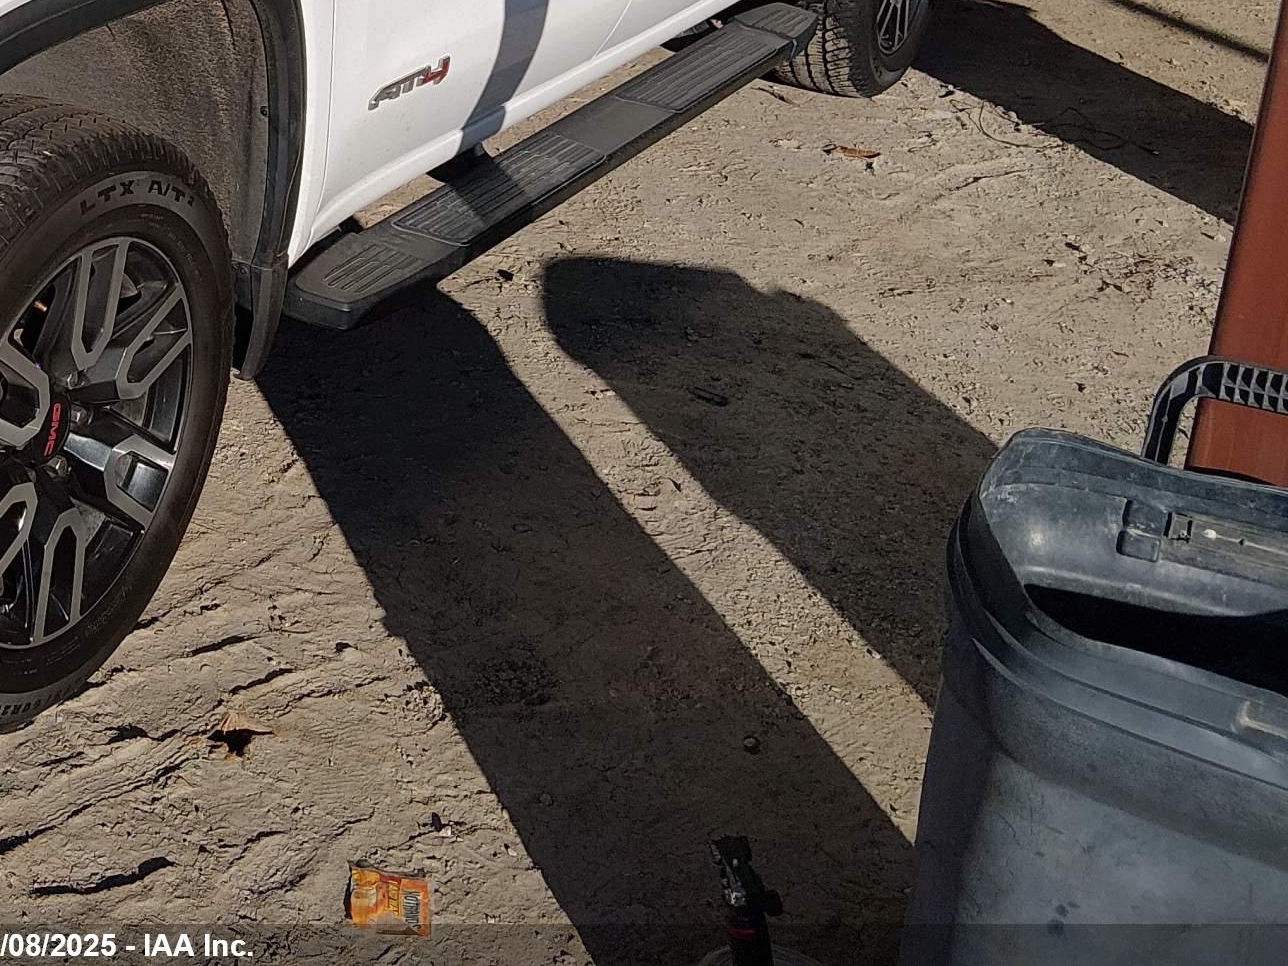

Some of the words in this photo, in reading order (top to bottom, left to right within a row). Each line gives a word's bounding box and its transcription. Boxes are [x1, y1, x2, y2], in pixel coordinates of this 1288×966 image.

[367, 55, 451, 111] AT4
[78, 179, 135, 217] LTX
[43, 402, 62, 457] GMC
